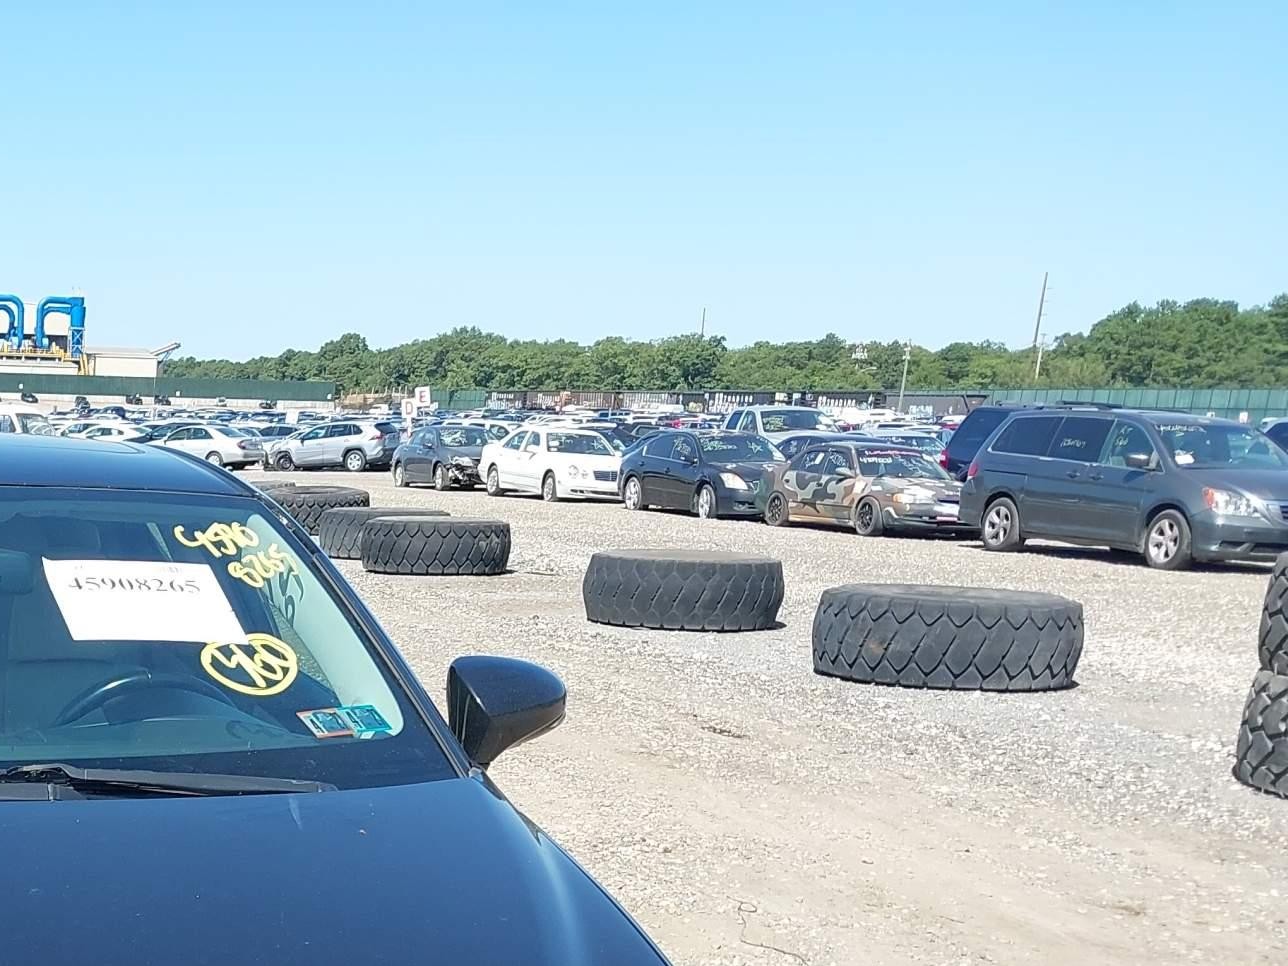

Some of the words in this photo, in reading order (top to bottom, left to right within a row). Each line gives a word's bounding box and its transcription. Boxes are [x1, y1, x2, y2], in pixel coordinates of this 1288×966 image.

[419, 390, 428, 403] E
[405, 401, 413, 415] D
[68, 577, 201, 594] 45908265
